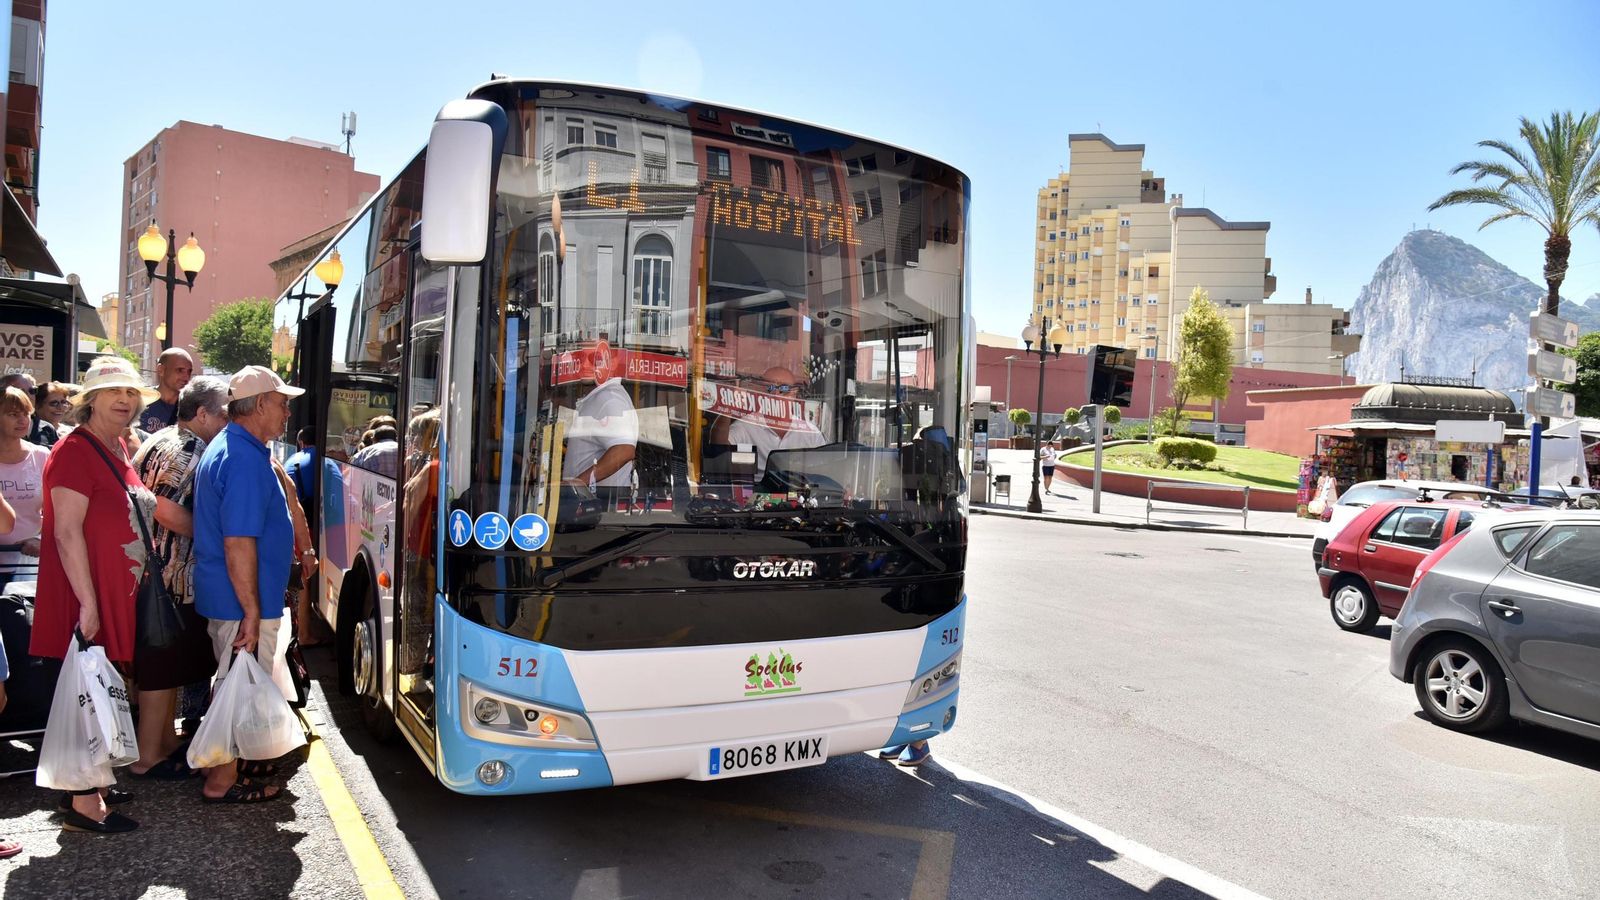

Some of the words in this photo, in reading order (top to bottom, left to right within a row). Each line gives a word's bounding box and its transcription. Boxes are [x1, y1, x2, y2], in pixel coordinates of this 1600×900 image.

[714, 196, 862, 246] HOSPITAL
[733, 560, 814, 578] OTOKAR
[941, 627, 959, 645] 512
[497, 657, 538, 678] 512
[745, 656, 803, 678] Socibus
[723, 744, 777, 770] 8068
[784, 737, 822, 762] KMX
